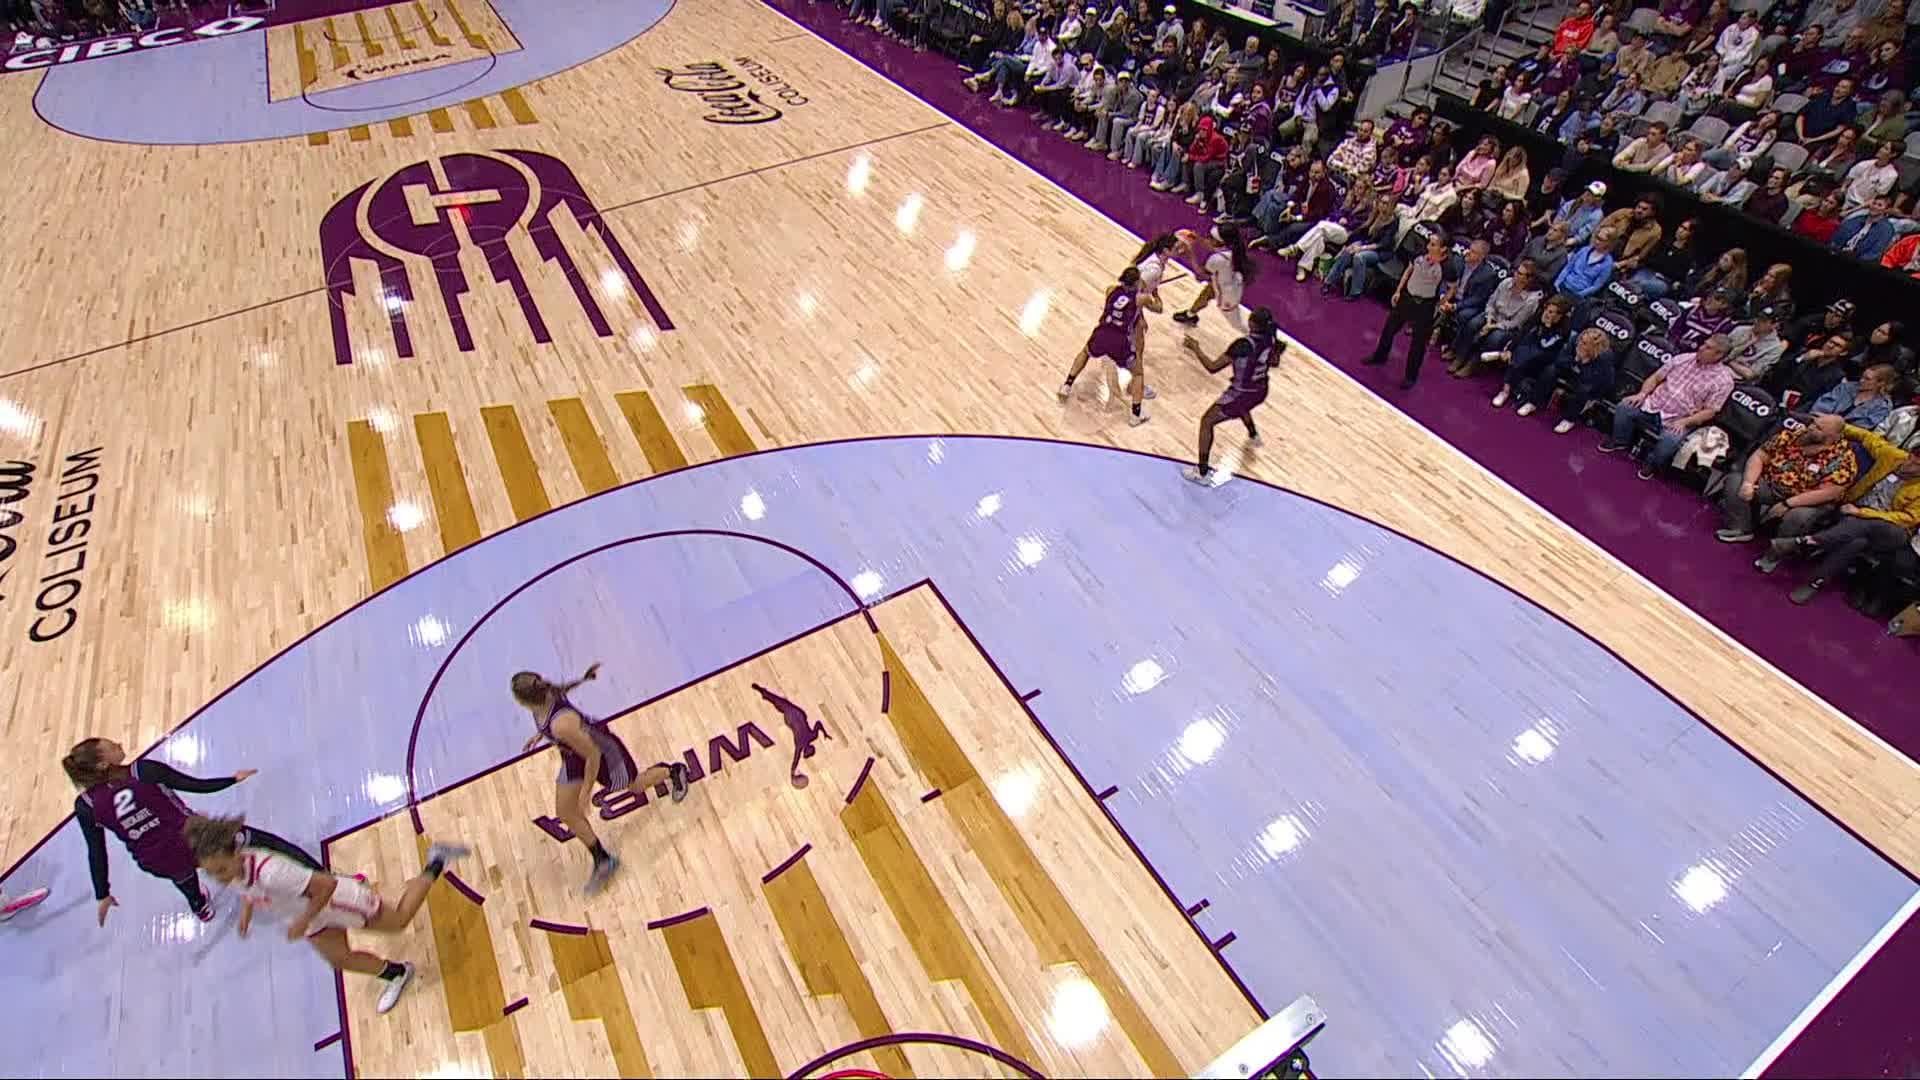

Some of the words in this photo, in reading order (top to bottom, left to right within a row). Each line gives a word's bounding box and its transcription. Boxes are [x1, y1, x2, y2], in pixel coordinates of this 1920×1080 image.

[734, 56, 809, 106] COLISEUM
[29, 446, 104, 642] COLISEUM
[113, 788, 137, 820] 2
